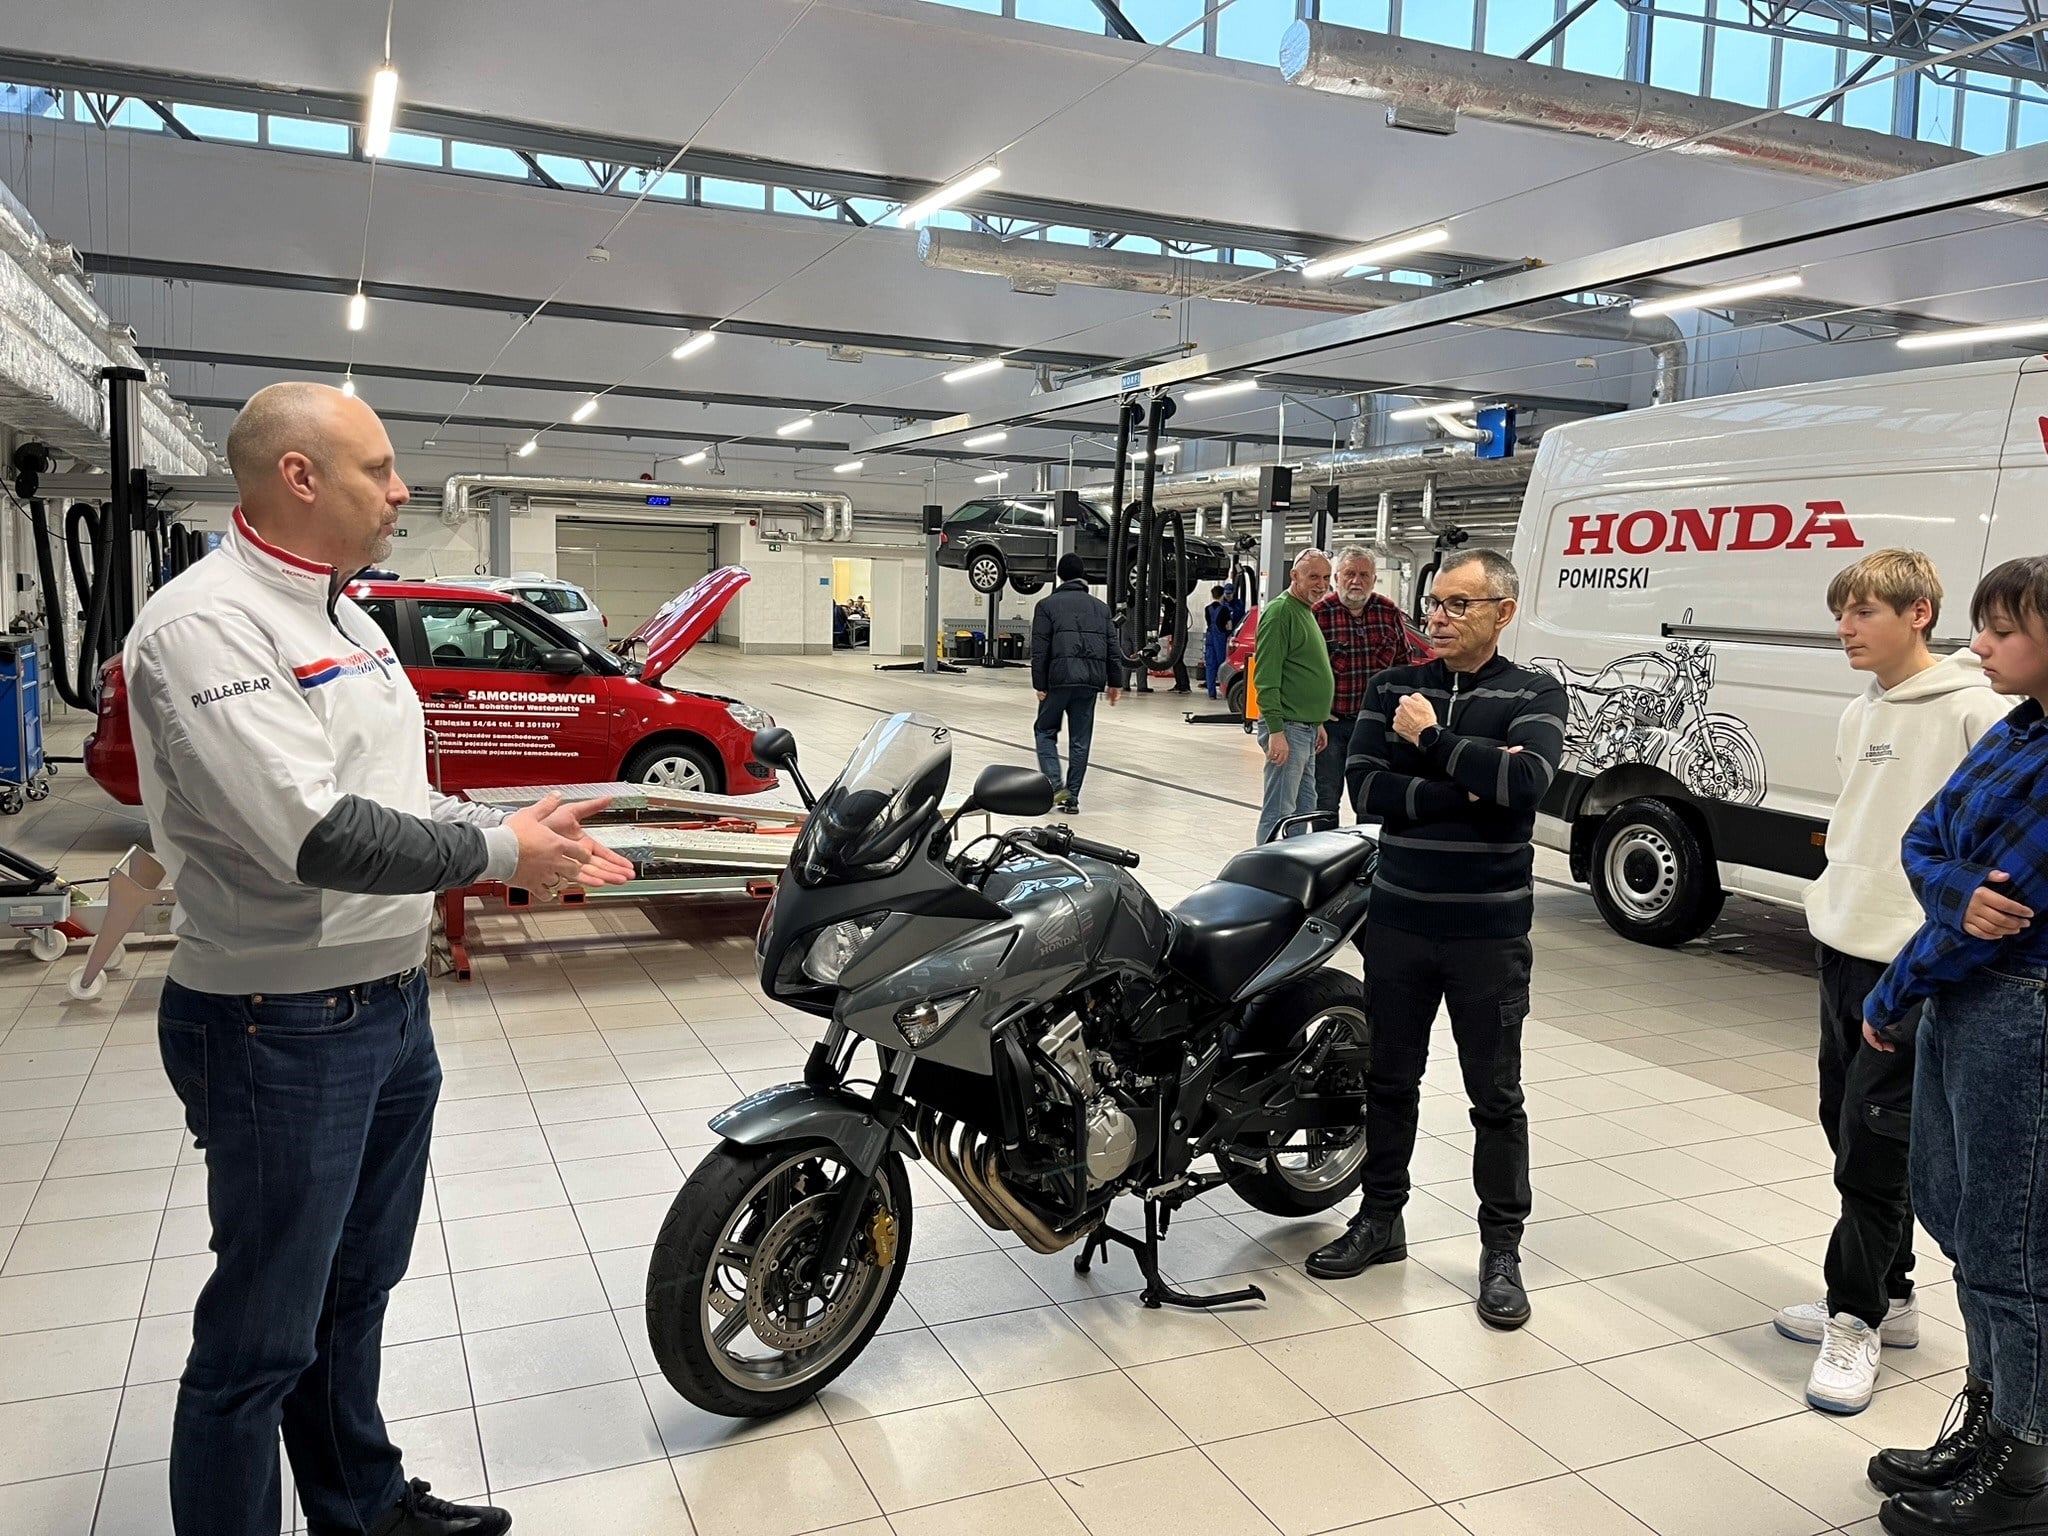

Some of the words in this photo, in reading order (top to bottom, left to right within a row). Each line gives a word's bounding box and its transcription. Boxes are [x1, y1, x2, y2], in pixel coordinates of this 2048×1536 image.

[1563, 501, 1864, 556] HONDA
[1558, 567, 1649, 589] POMIRSKI
[191, 677, 272, 708] PULL&BEAR
[467, 690, 596, 704] SAMOCHODOWYCH
[479, 703, 525, 711] Bohaterów
[527, 704, 580, 712] Westerplatte
[457, 732, 491, 741] pojazdów
[464, 740, 499, 748] pojazdów
[499, 742, 556, 750] samochodowych
[488, 749, 523, 757] pojazdów
[1040, 935, 1078, 956] HONDA
